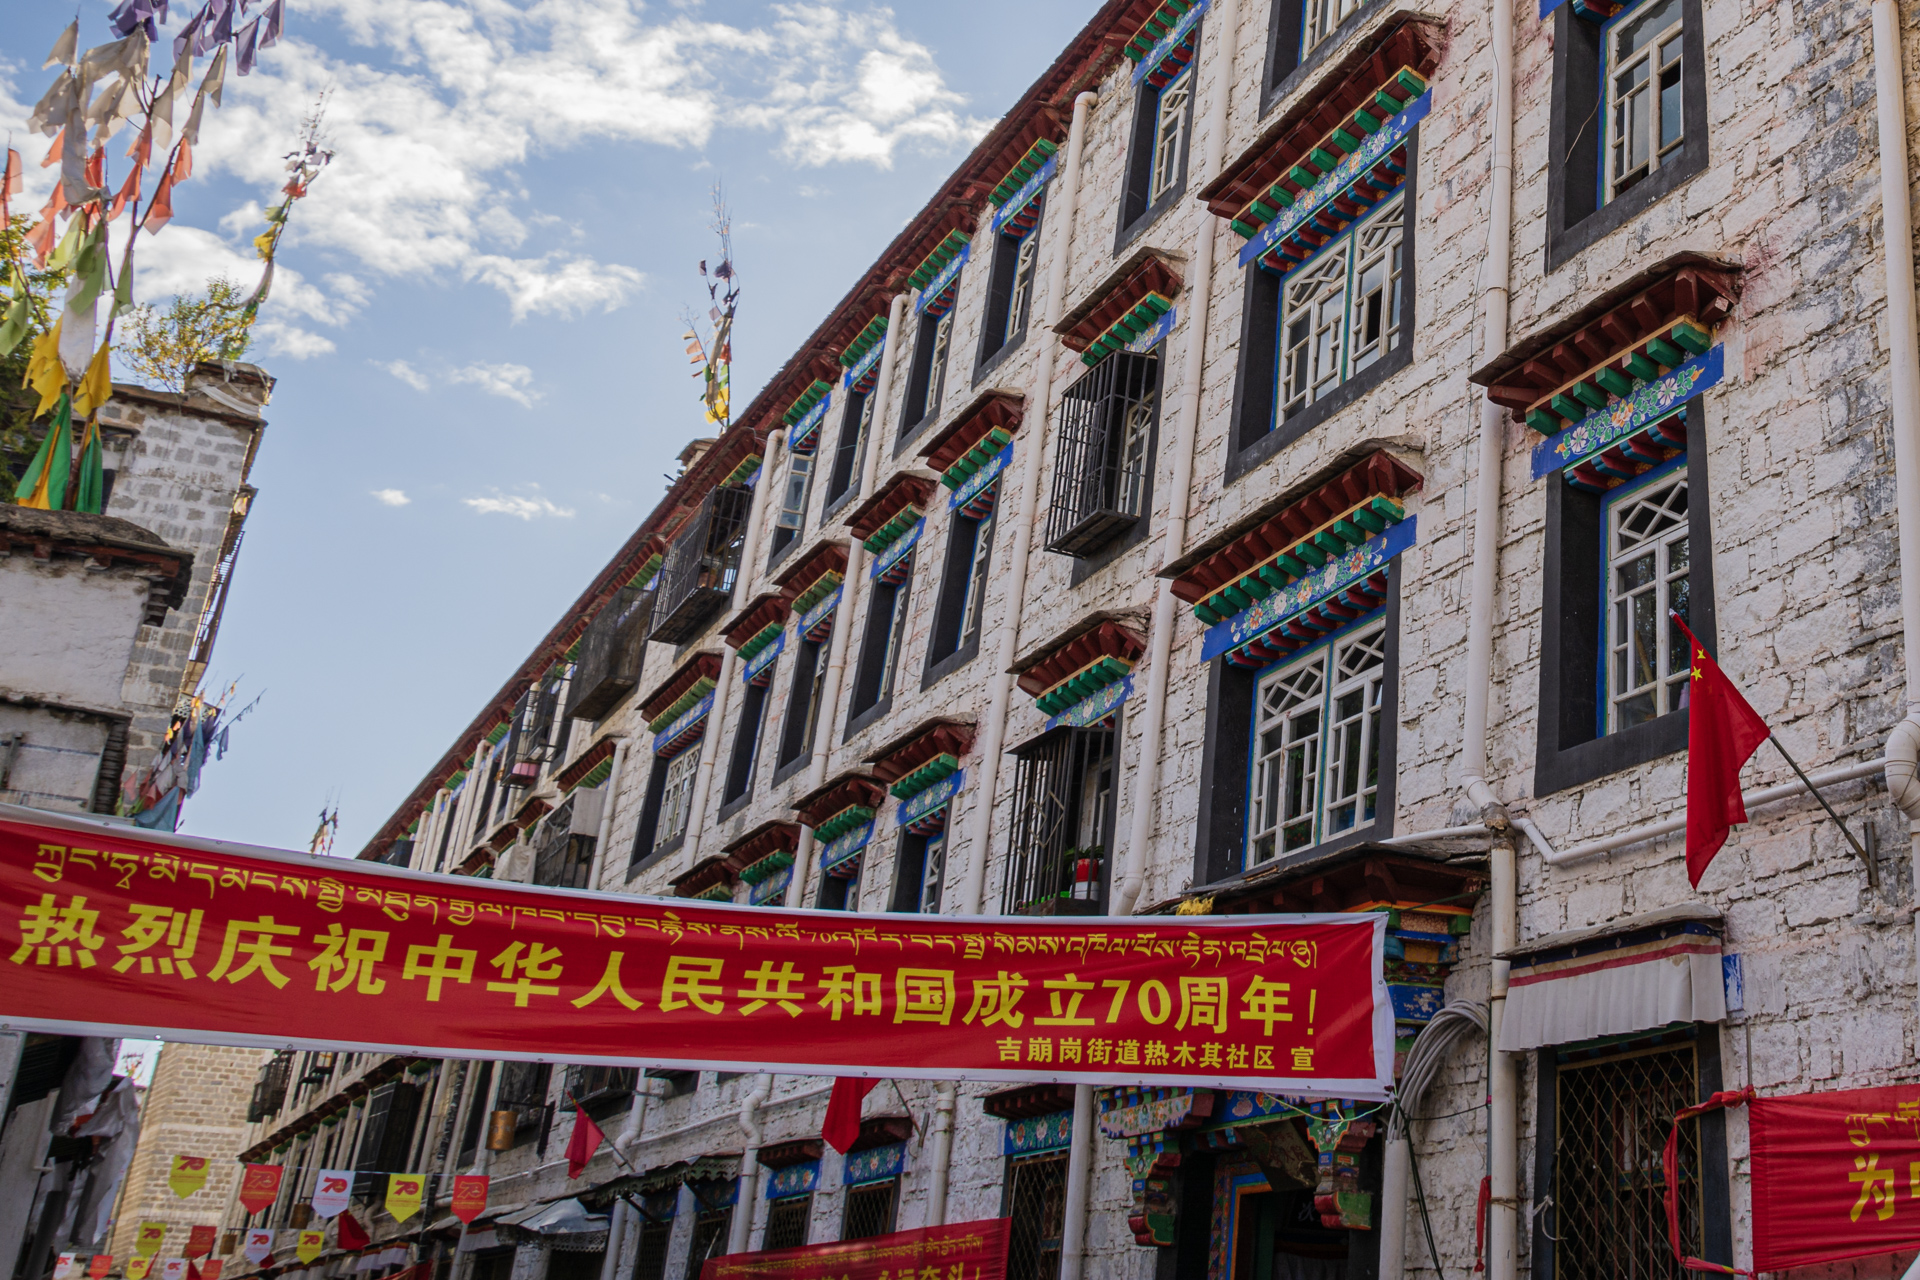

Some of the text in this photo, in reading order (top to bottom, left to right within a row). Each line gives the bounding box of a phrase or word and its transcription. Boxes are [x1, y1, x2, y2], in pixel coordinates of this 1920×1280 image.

[9, 893, 1317, 1037] 热烈庆祝中华人民共和国成立70周年！
[996, 1036, 1315, 1071] 吉崩岗街道热木其社区 宣
[246, 1170, 278, 1189] 70
[320, 1176, 348, 1193] 70
[393, 1180, 420, 1196] 70
[457, 1181, 485, 1199] 70
